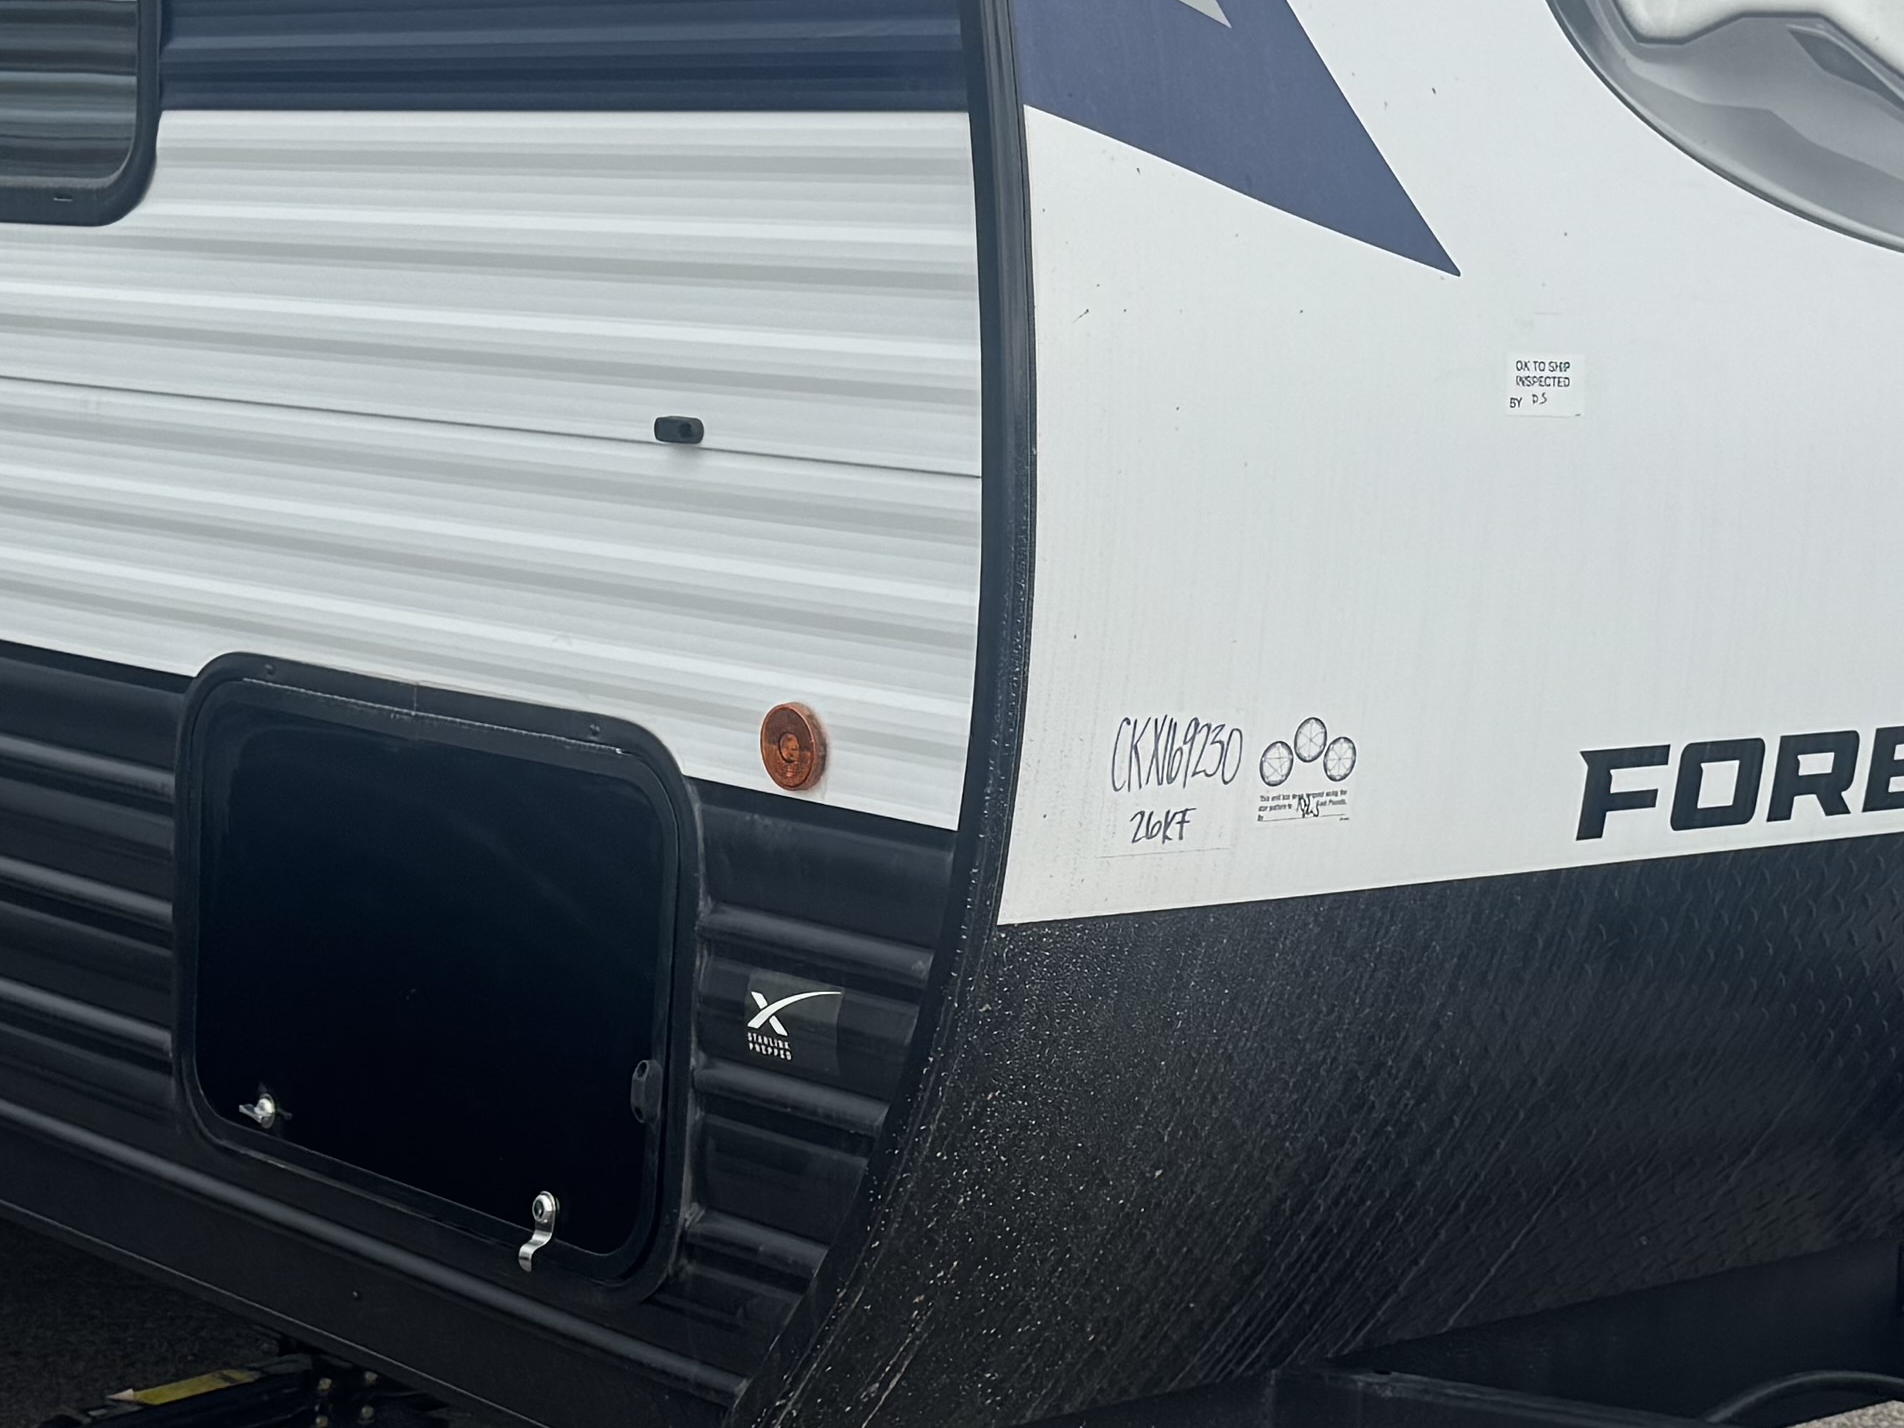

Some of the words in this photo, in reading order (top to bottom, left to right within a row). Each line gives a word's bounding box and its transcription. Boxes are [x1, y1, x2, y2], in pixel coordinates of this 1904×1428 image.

[1515, 359, 1529, 371] OK
[1532, 360, 1545, 371] TO
[1515, 375, 1570, 387] INSPECTED
[1509, 397, 1522, 408] BY
